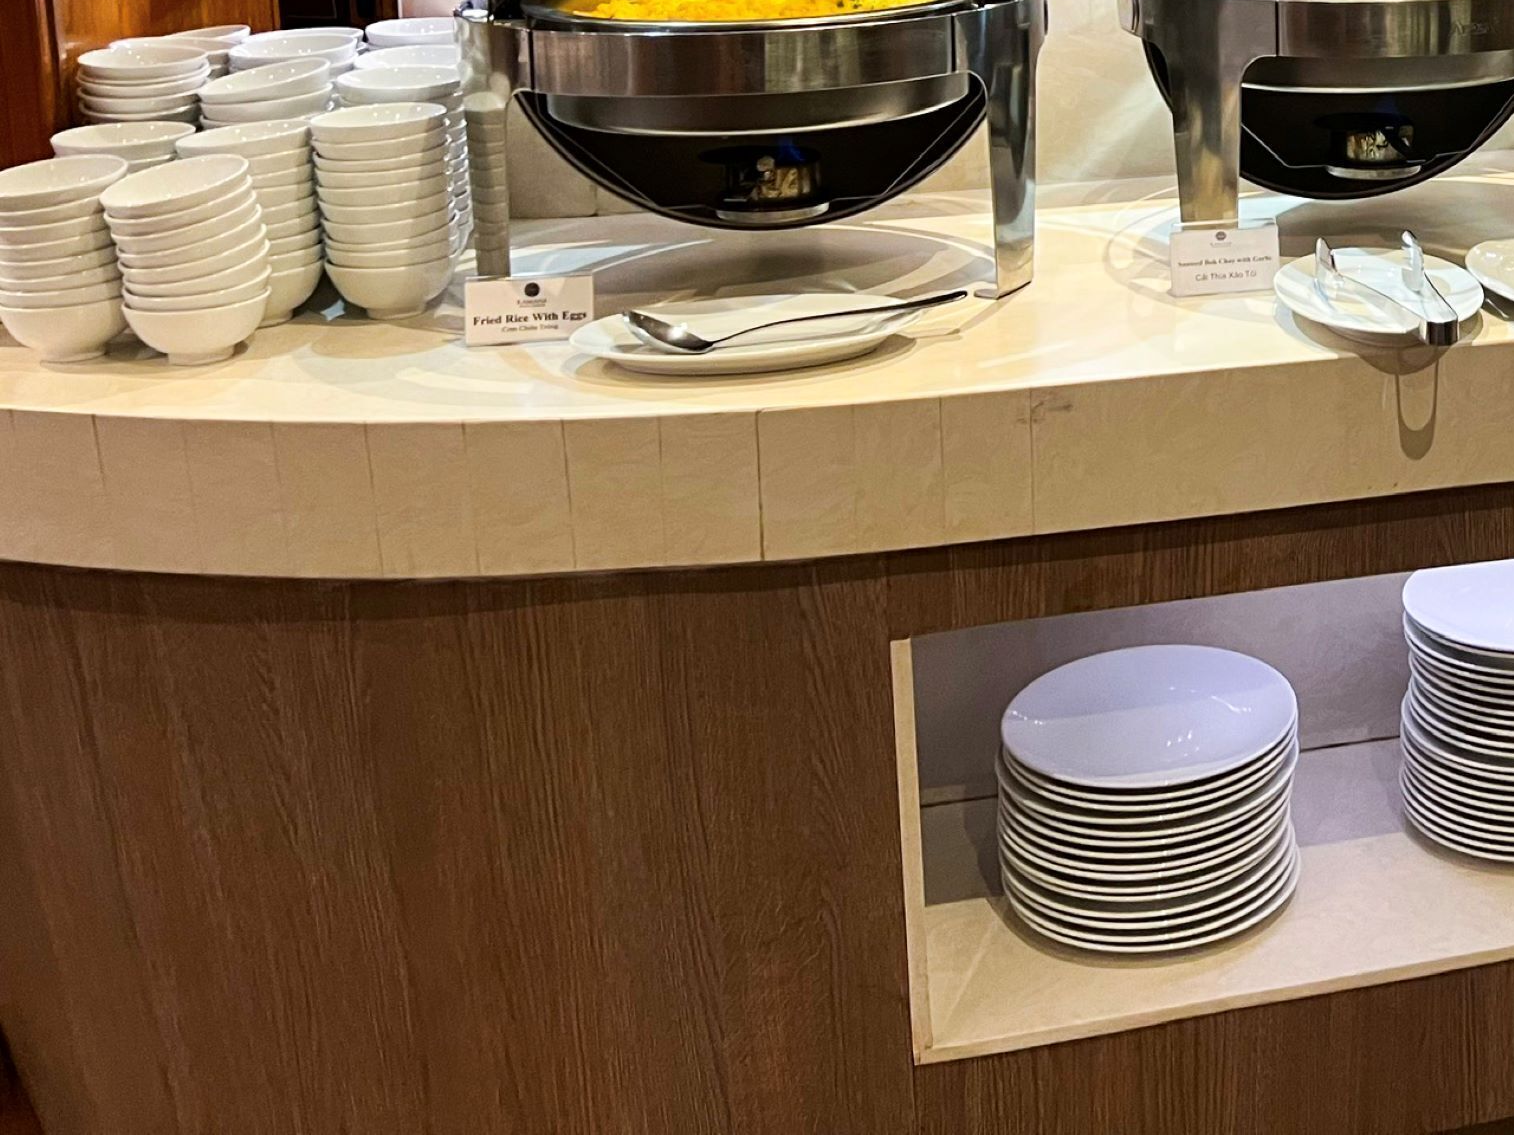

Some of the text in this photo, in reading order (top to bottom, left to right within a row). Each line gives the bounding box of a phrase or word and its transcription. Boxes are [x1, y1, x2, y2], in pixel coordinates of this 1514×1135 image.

[473, 310, 587, 326] Fried Rice With Eggs
